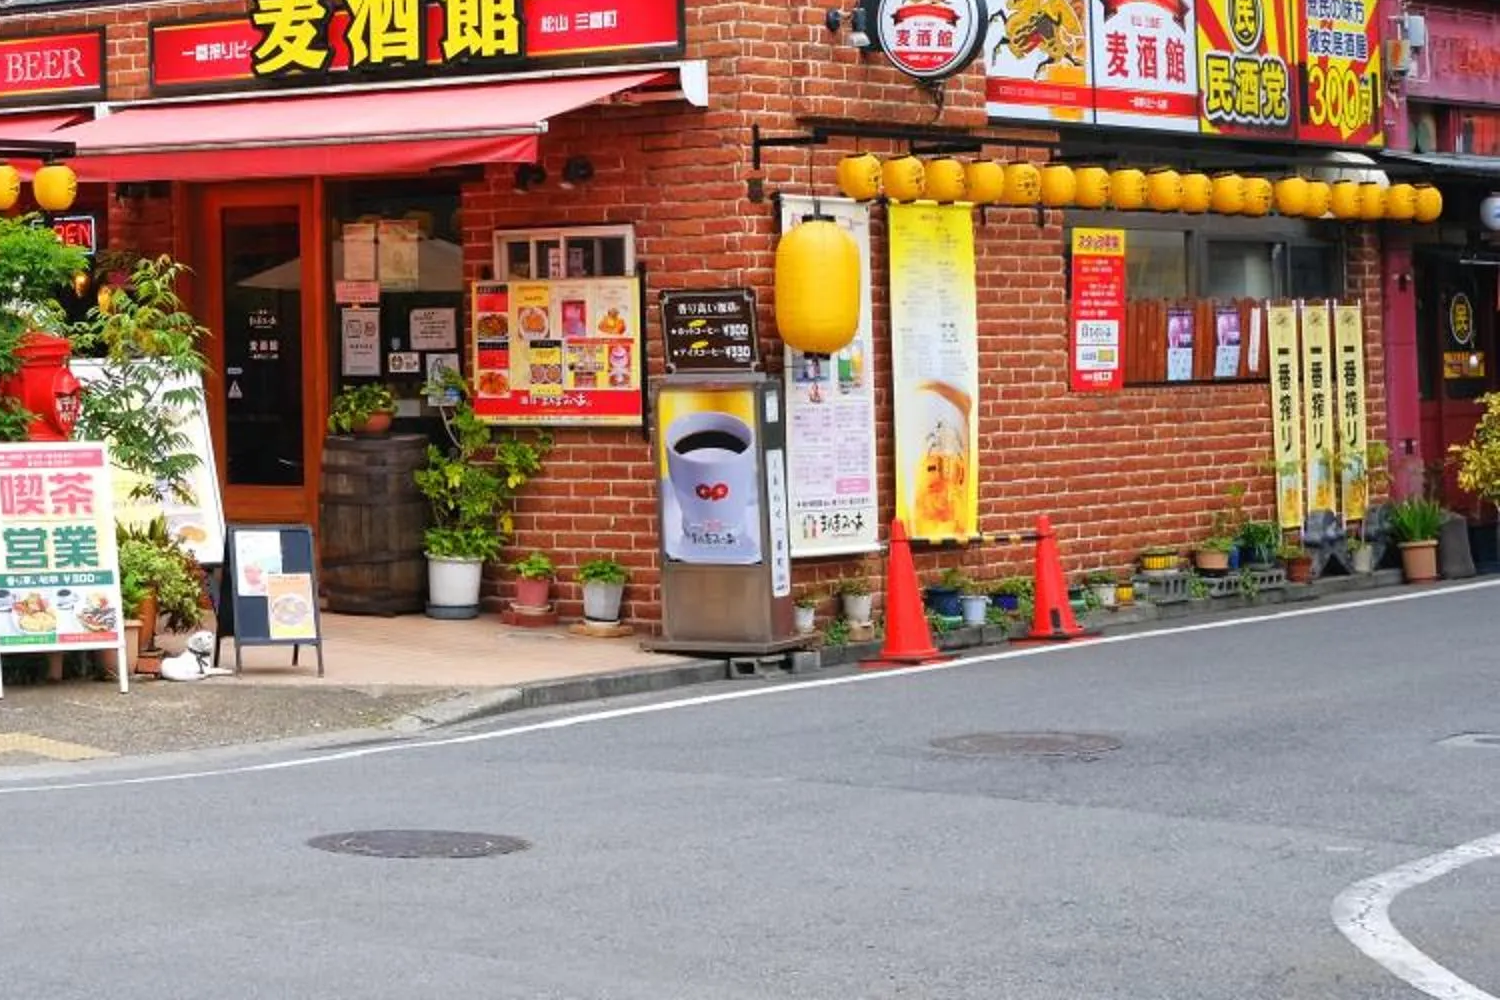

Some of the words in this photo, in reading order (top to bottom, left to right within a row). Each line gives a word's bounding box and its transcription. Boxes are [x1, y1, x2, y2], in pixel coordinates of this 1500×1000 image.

[4, 46, 86, 85] BEER
[895, 29, 954, 48] 麦酒館
[1105, 30, 1187, 84] 麦酒館
[1205, 56, 1287, 121] 民酒党
[53, 223, 92, 247] PEN
[1277, 347, 1291, 452] 一番搾り
[1310, 346, 1324, 450] 一番搾り
[1343, 345, 1357, 447] 一番搾り
[2, 525, 99, 569] 営業
